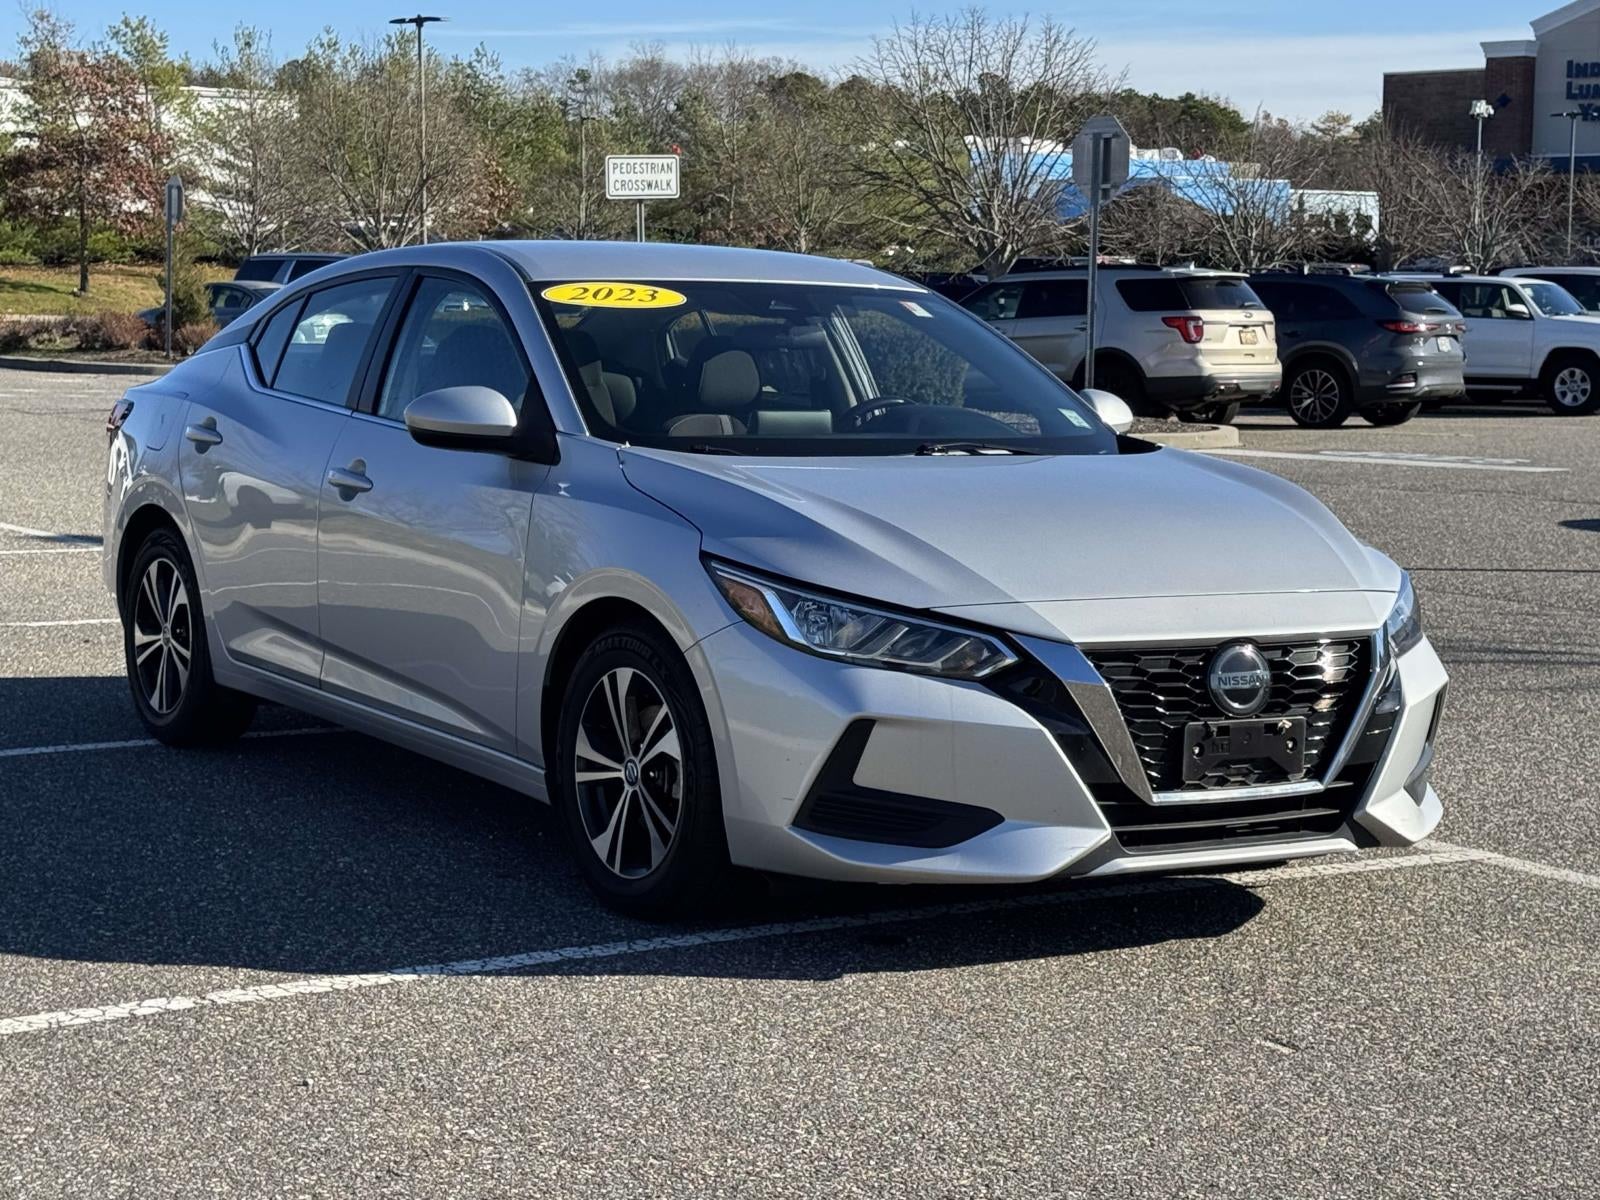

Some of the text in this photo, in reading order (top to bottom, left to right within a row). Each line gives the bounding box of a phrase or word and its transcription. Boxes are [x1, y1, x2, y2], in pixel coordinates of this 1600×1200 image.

[612, 162, 673, 175] PEDESTRIAN
[613, 179, 673, 192] CROSSWALK
[567, 286, 659, 303] 2023
[1217, 674, 1265, 687] NISSAN
